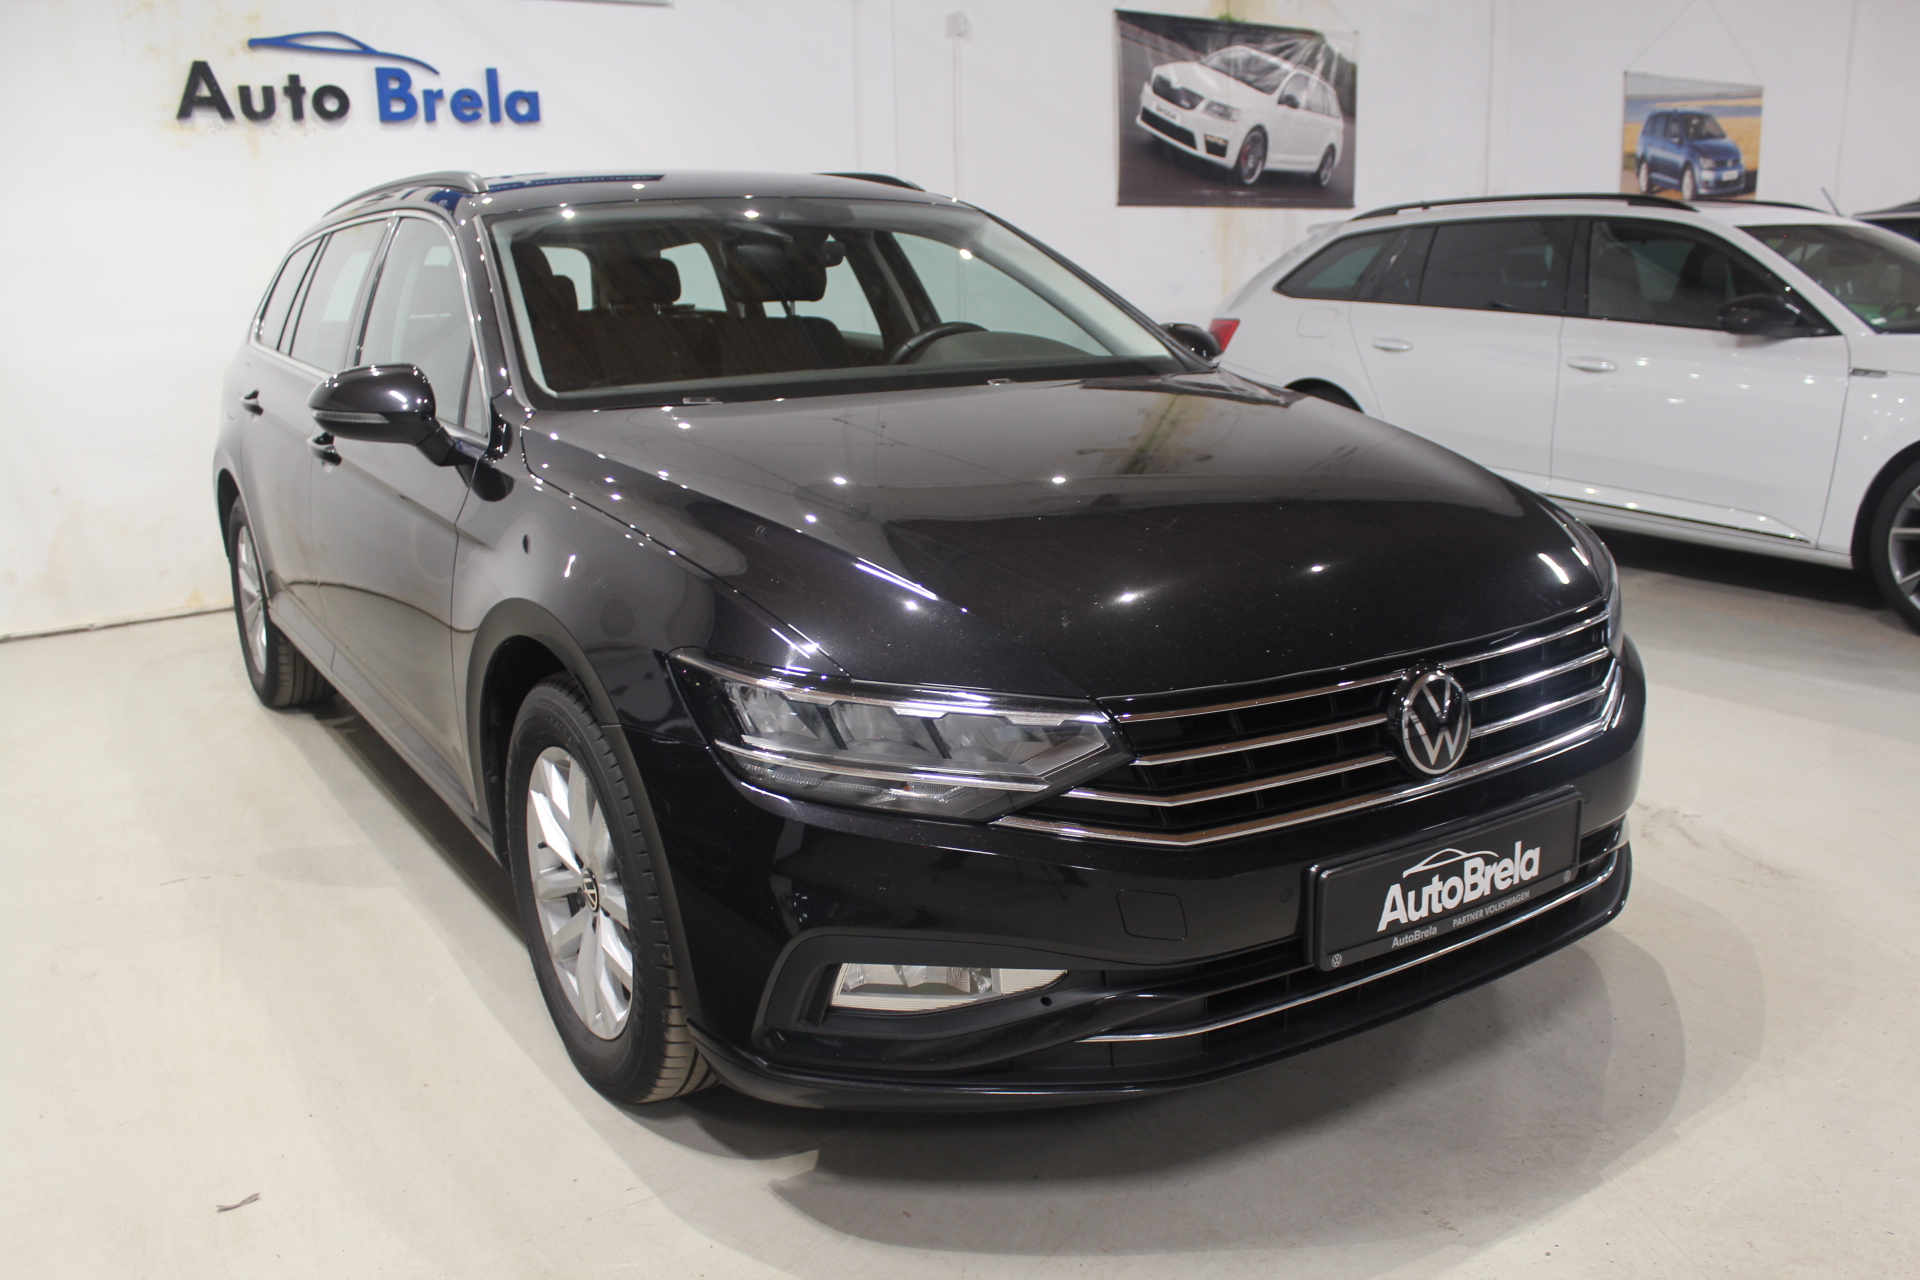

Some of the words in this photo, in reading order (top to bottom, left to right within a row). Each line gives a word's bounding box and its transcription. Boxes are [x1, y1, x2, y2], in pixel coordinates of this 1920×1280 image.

[176, 60, 350, 121] Auto
[374, 66, 541, 124] Brela
[1377, 841, 1541, 932] AutoBrela
[1452, 909, 1484, 928] PARTNER
[1485, 890, 1530, 915] VOLKSWAGEN
[1391, 925, 1438, 949] AutoBrela
